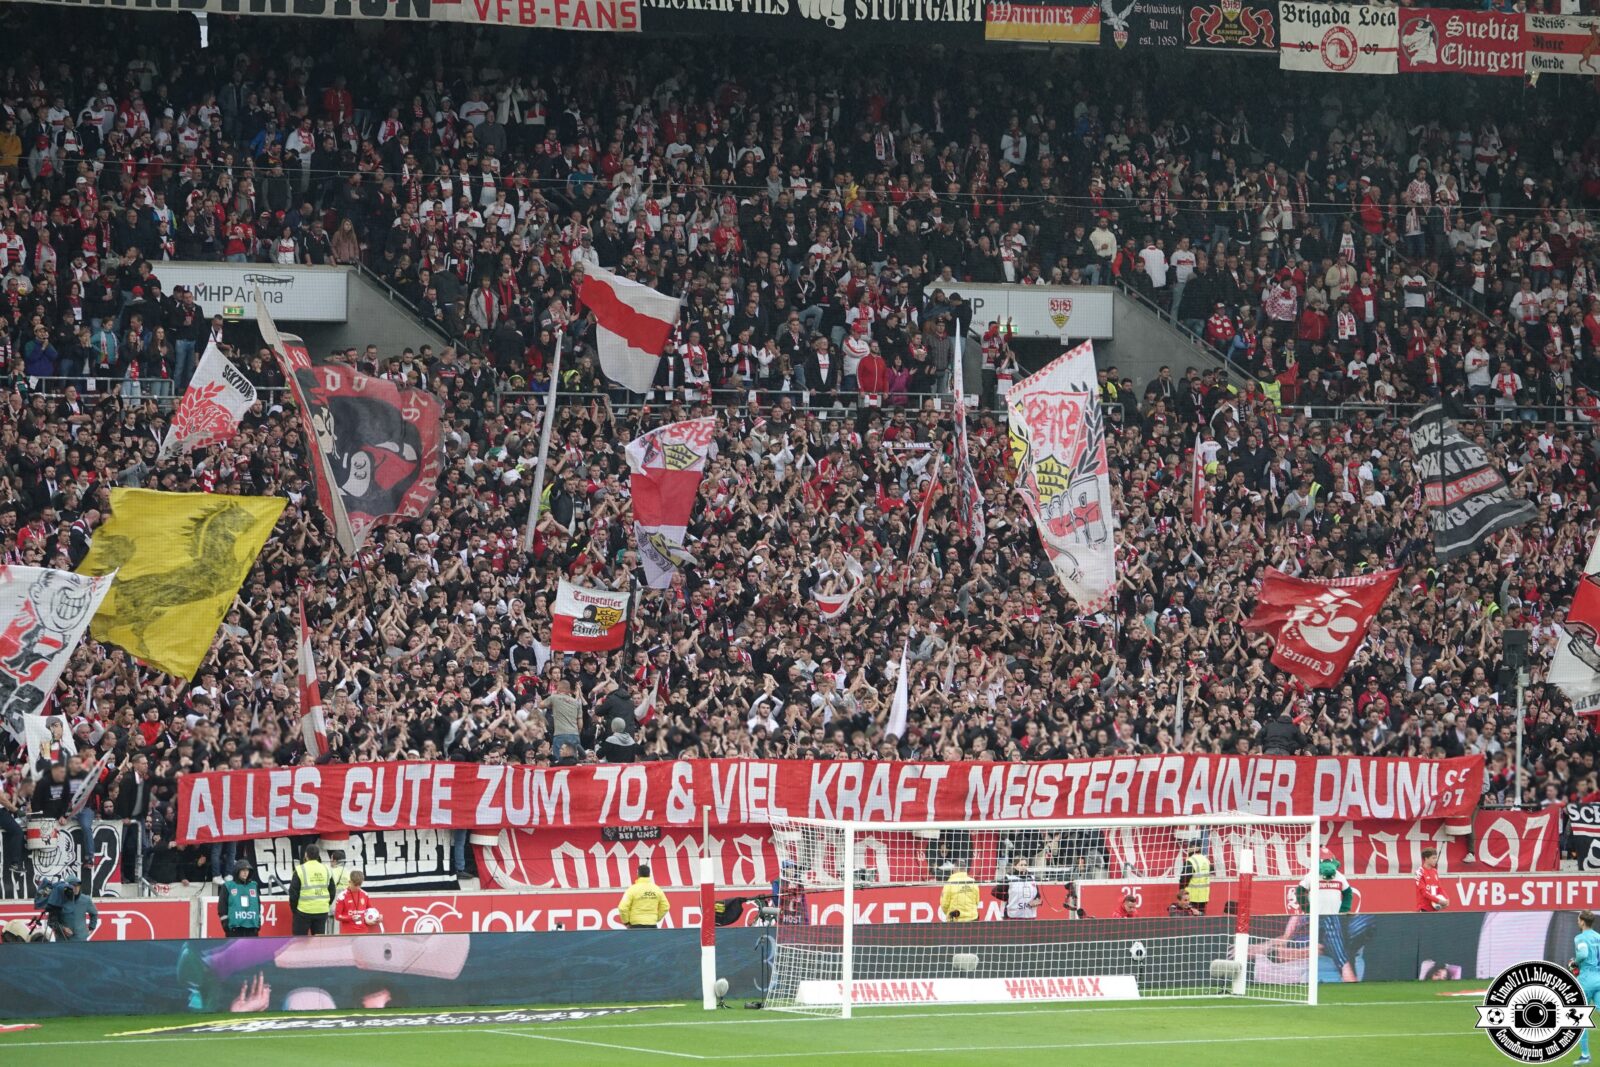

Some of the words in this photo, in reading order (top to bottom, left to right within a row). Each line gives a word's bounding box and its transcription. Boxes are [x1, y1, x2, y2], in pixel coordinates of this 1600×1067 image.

[474, 0, 637, 28] VFB-FANS
[990, 2, 1074, 26] Warriors
[1282, 4, 1350, 28] Brigada
[1358, 7, 1397, 26] Loca
[1446, 15, 1520, 42] Suebia
[186, 767, 322, 840] ALLES
[340, 763, 456, 828] GUTE
[475, 765, 571, 826] ZUM
[593, 765, 655, 824] 70.
[666, 761, 697, 824] &
[710, 762, 789, 824] VIEL
[808, 761, 950, 822] KRAFT
[965, 756, 1297, 822] MEISTERTRAINER
[1313, 758, 1438, 819] DAUM!
[1442, 788, 1465, 808] 97
[1479, 813, 1551, 872] 97
[234, 911, 256, 920] HOST
[1004, 977, 1104, 998] WINAMAX
